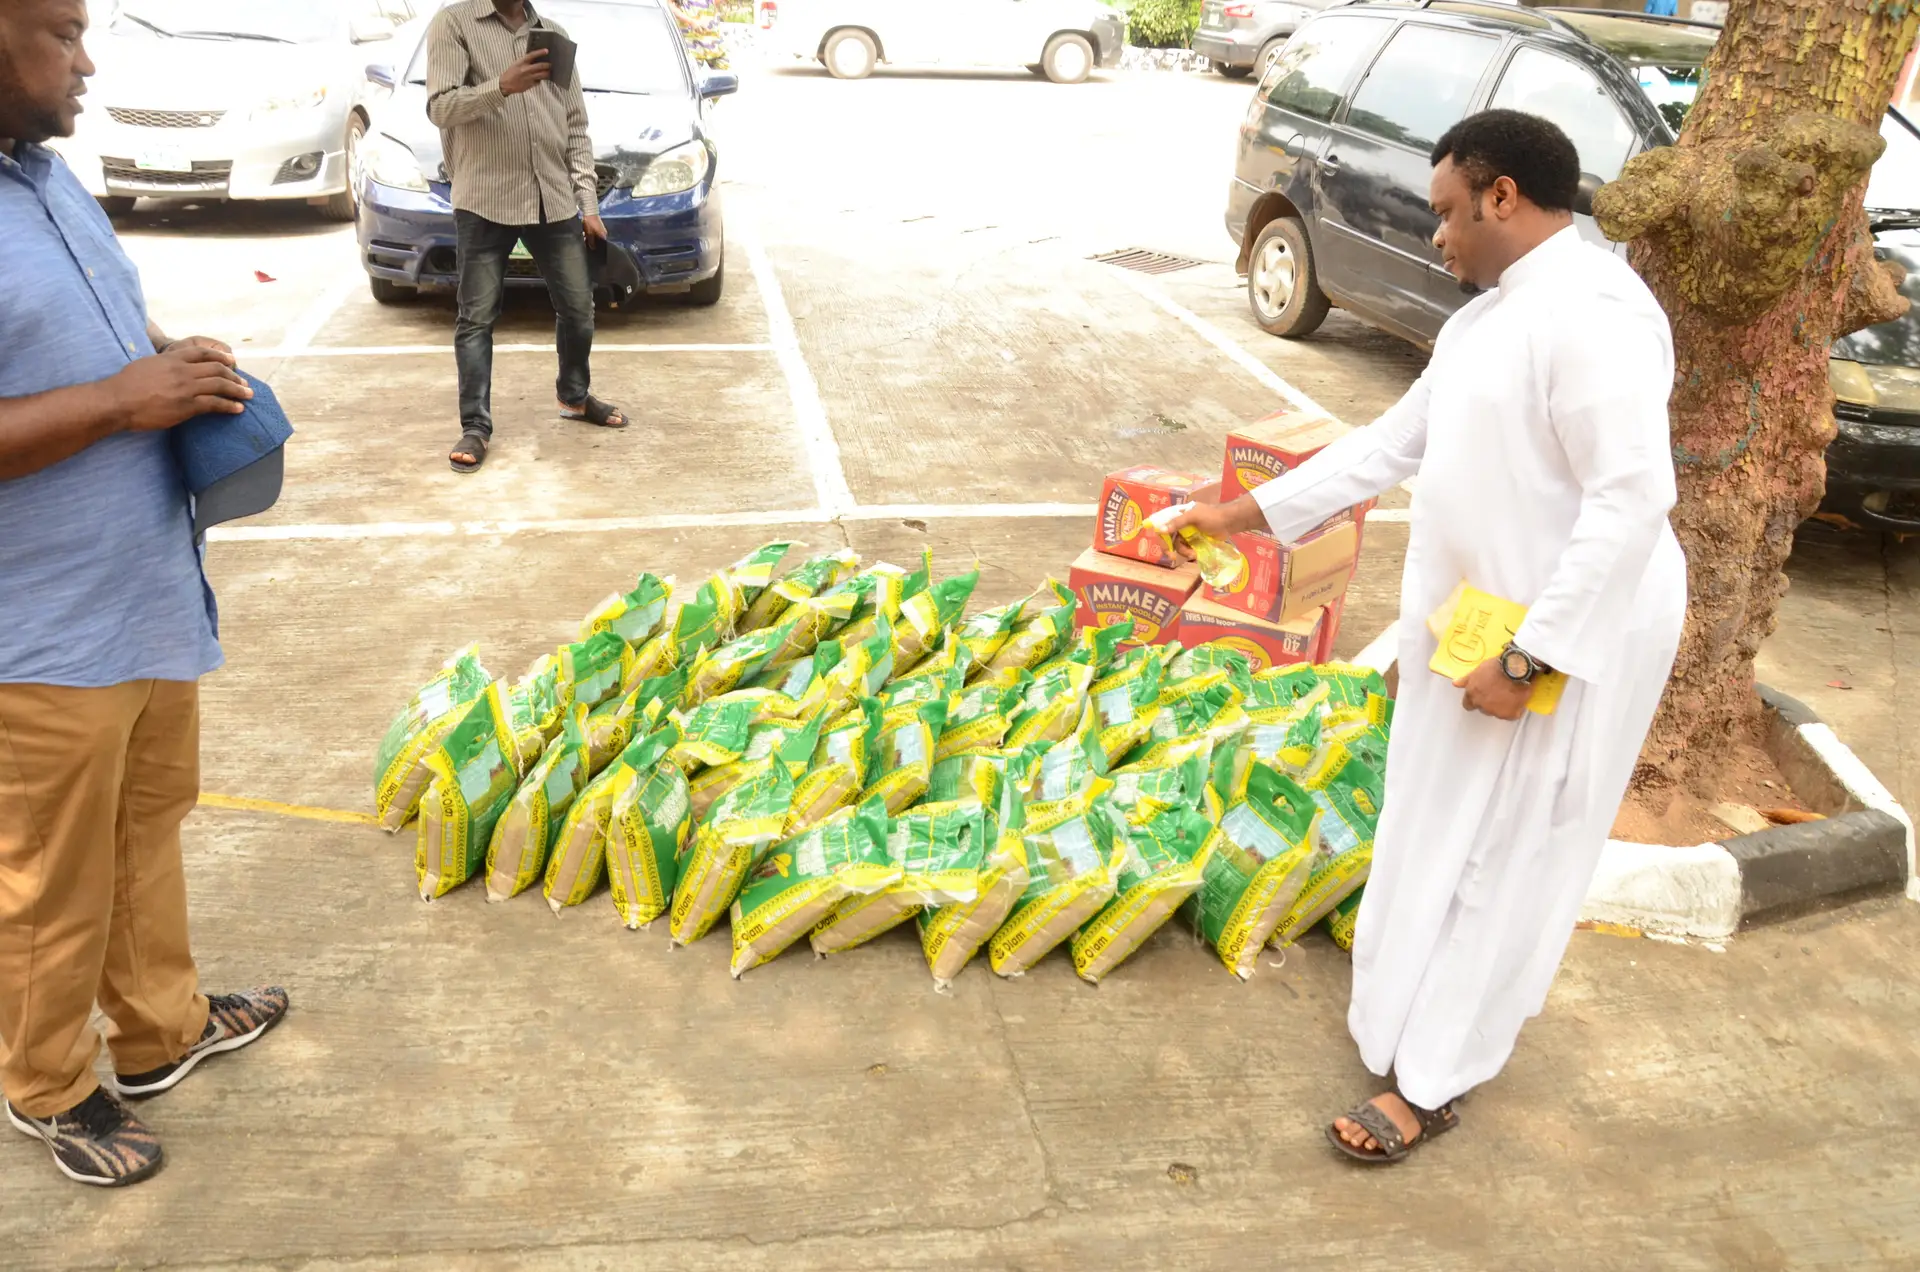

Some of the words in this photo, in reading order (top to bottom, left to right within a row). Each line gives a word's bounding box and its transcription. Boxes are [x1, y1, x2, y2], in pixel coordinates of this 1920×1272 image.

[1235, 448, 1283, 474] MIMEE
[1103, 491, 1123, 542] MIMEE
[1093, 584, 1170, 617] MIMEE
[1283, 637, 1300, 651] 40
[379, 781, 399, 803] Olam
[623, 827, 636, 847] Olam
[675, 891, 693, 917] Olam
[740, 923, 763, 941] Olam
[814, 911, 838, 932] Olam
[1002, 929, 1025, 951] Olam
[1083, 934, 1107, 958] Olam
[1228, 927, 1248, 953] Olam
